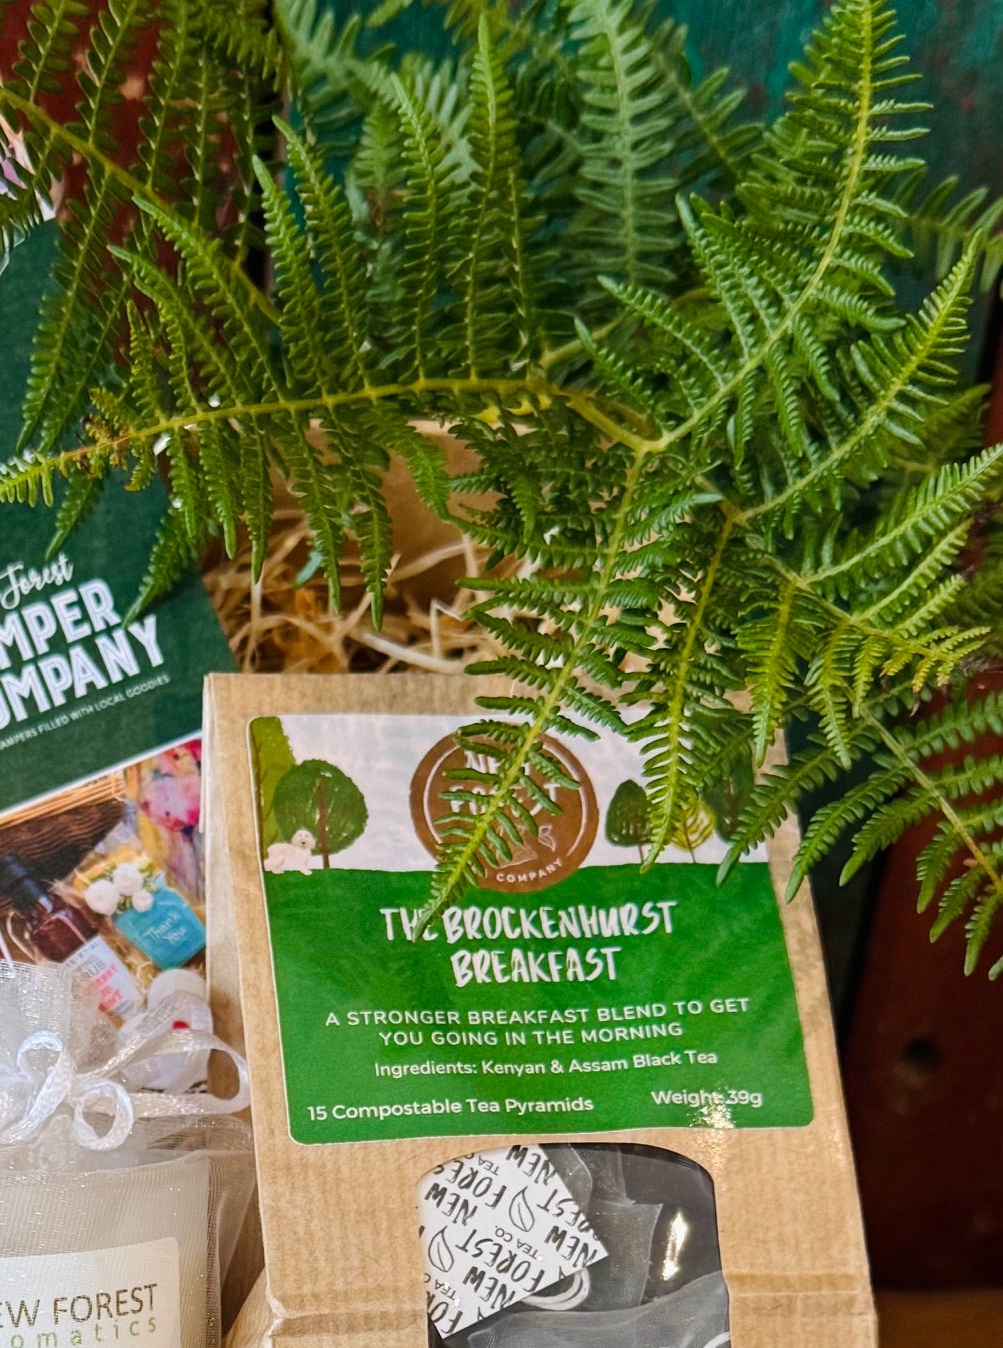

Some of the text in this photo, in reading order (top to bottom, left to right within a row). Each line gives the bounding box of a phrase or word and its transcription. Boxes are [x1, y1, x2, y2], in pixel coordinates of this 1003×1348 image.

[37, 713, 70, 734] FILLED
[70, 703, 95, 722] WITH
[94, 691, 126, 712] LOCAL
[496, 858, 563, 883] COMPANY
[442, 900, 678, 945] BROCKENHURST
[450, 947, 622, 989] BREAKFAST
[325, 998, 751, 1027] A STRONGER BREAKFAST BLEND TO GET
[379, 1022, 684, 1047] YOU GOING IN THE MORNING
[374, 1049, 719, 1080] Ingredients: Kenyan & Assam Black Tea
[308, 1095, 595, 1122] 15 Compostable Tea Pyramids
[726, 1089, 763, 1108] 39g
[477, 1155, 500, 1176] TEA
[424, 1182, 478, 1227] NEW
[455, 1228, 545, 1293] FOREST
[494, 1225, 539, 1260] TEA CO.
[544, 1225, 598, 1269] NEW
[53, 1283, 158, 1326] FOREST
[462, 1265, 516, 1310] NEW
